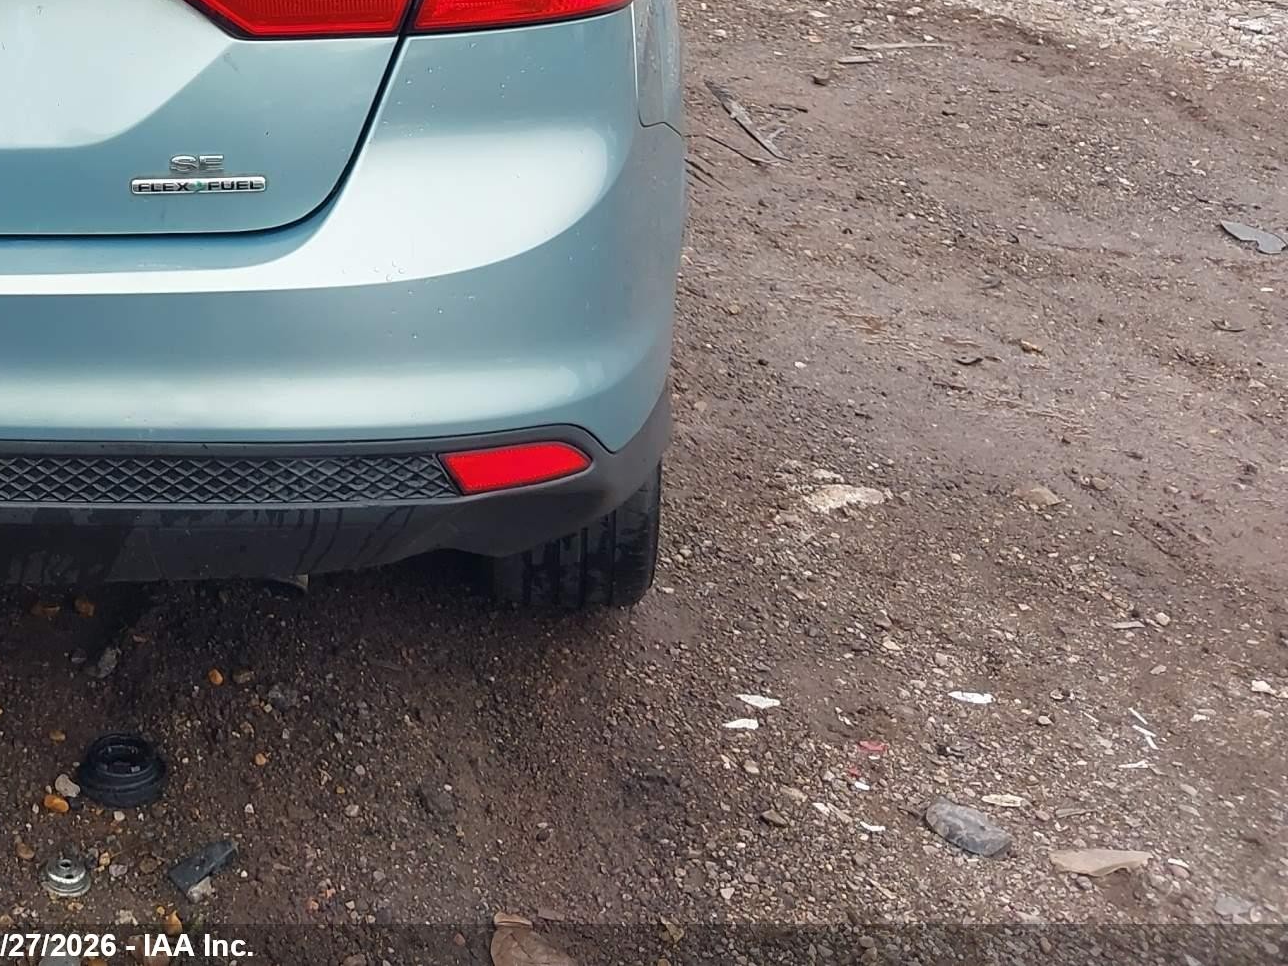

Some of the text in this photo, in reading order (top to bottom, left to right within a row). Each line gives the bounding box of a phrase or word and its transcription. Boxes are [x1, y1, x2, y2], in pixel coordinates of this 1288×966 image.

[170, 154, 225, 173] SE
[137, 180, 264, 193] FLEX FUEL
